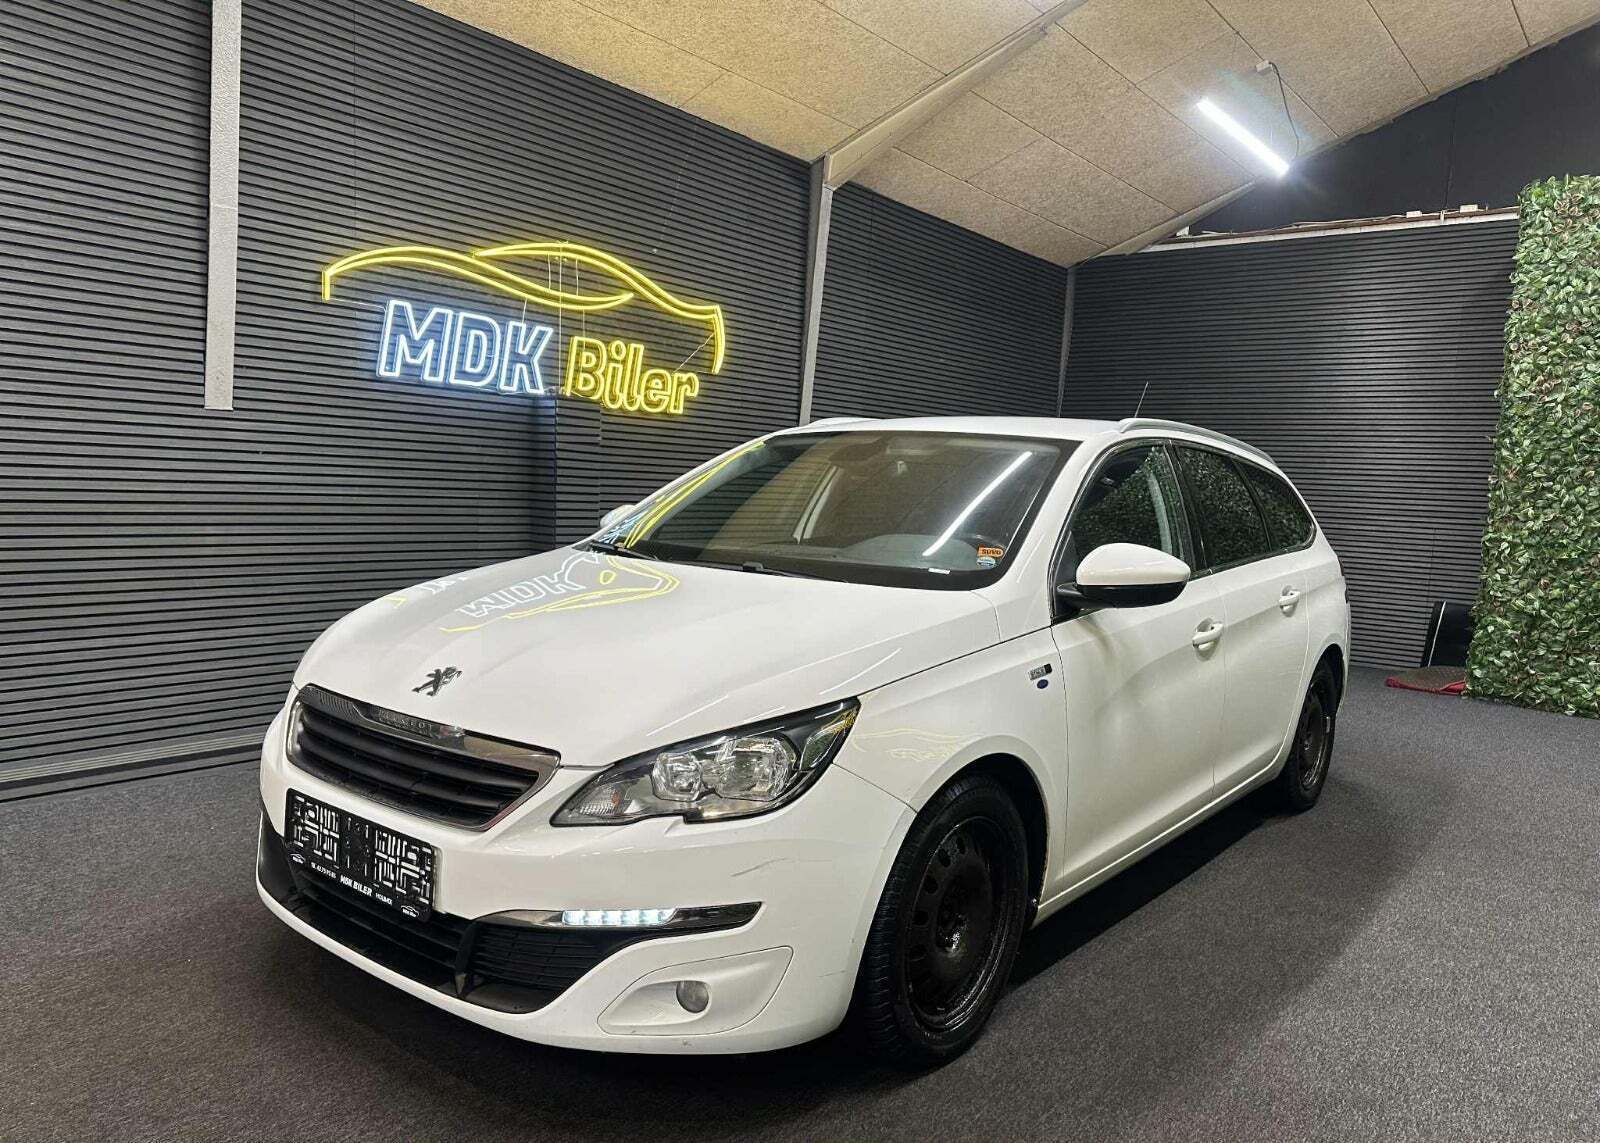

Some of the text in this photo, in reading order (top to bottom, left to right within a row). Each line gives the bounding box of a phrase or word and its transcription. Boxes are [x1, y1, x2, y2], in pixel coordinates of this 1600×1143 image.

[376, 300, 700, 415] MDK Biler
[353, 881, 373, 896] BILER
